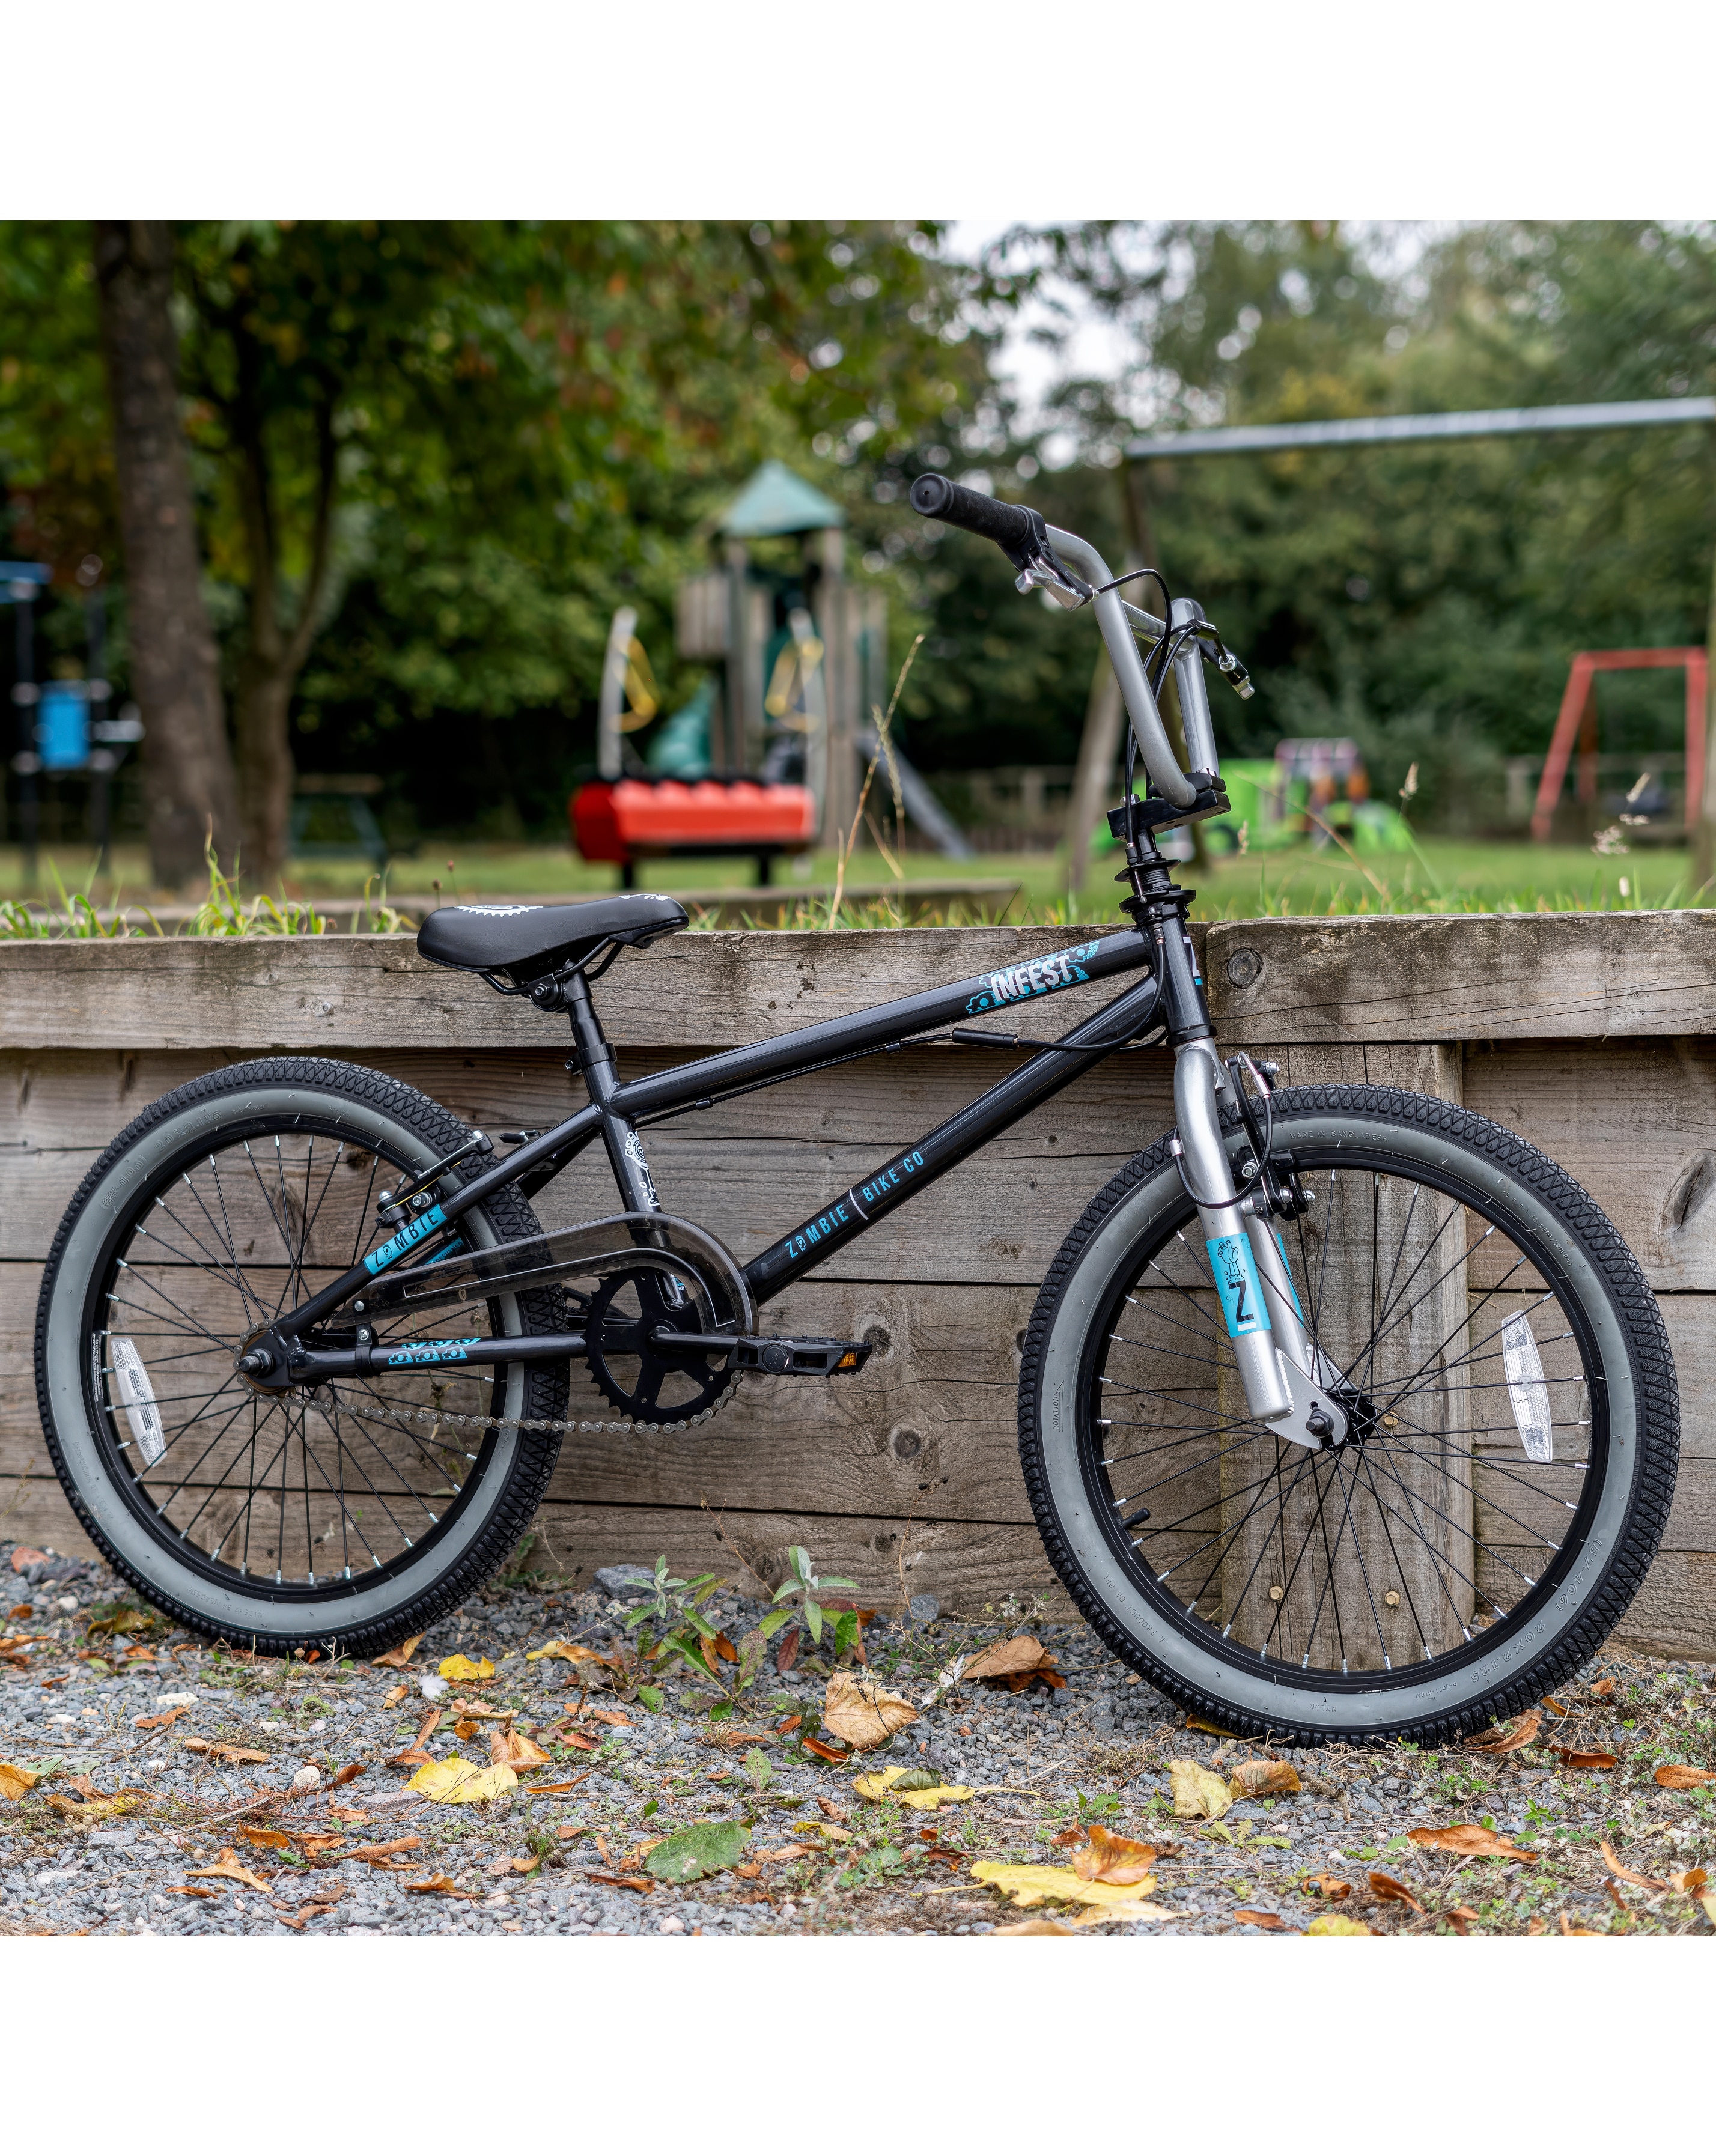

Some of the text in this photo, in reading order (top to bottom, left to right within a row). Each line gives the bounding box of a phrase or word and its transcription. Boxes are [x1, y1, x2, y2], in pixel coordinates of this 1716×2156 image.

[990, 954, 1072, 1002] INFEST
[1289, 1131, 1314, 1140] MADE
[862, 1168, 900, 1202] BIKE
[903, 1151, 924, 1173] CO
[1228, 1279, 1255, 1323] Z
[1103, 1573, 1116, 1588] RFL
[1115, 1593, 1126, 1602] OF
[1125, 1605, 1157, 1636] PRODUCT
[1309, 1704, 1337, 1713] NYLON
